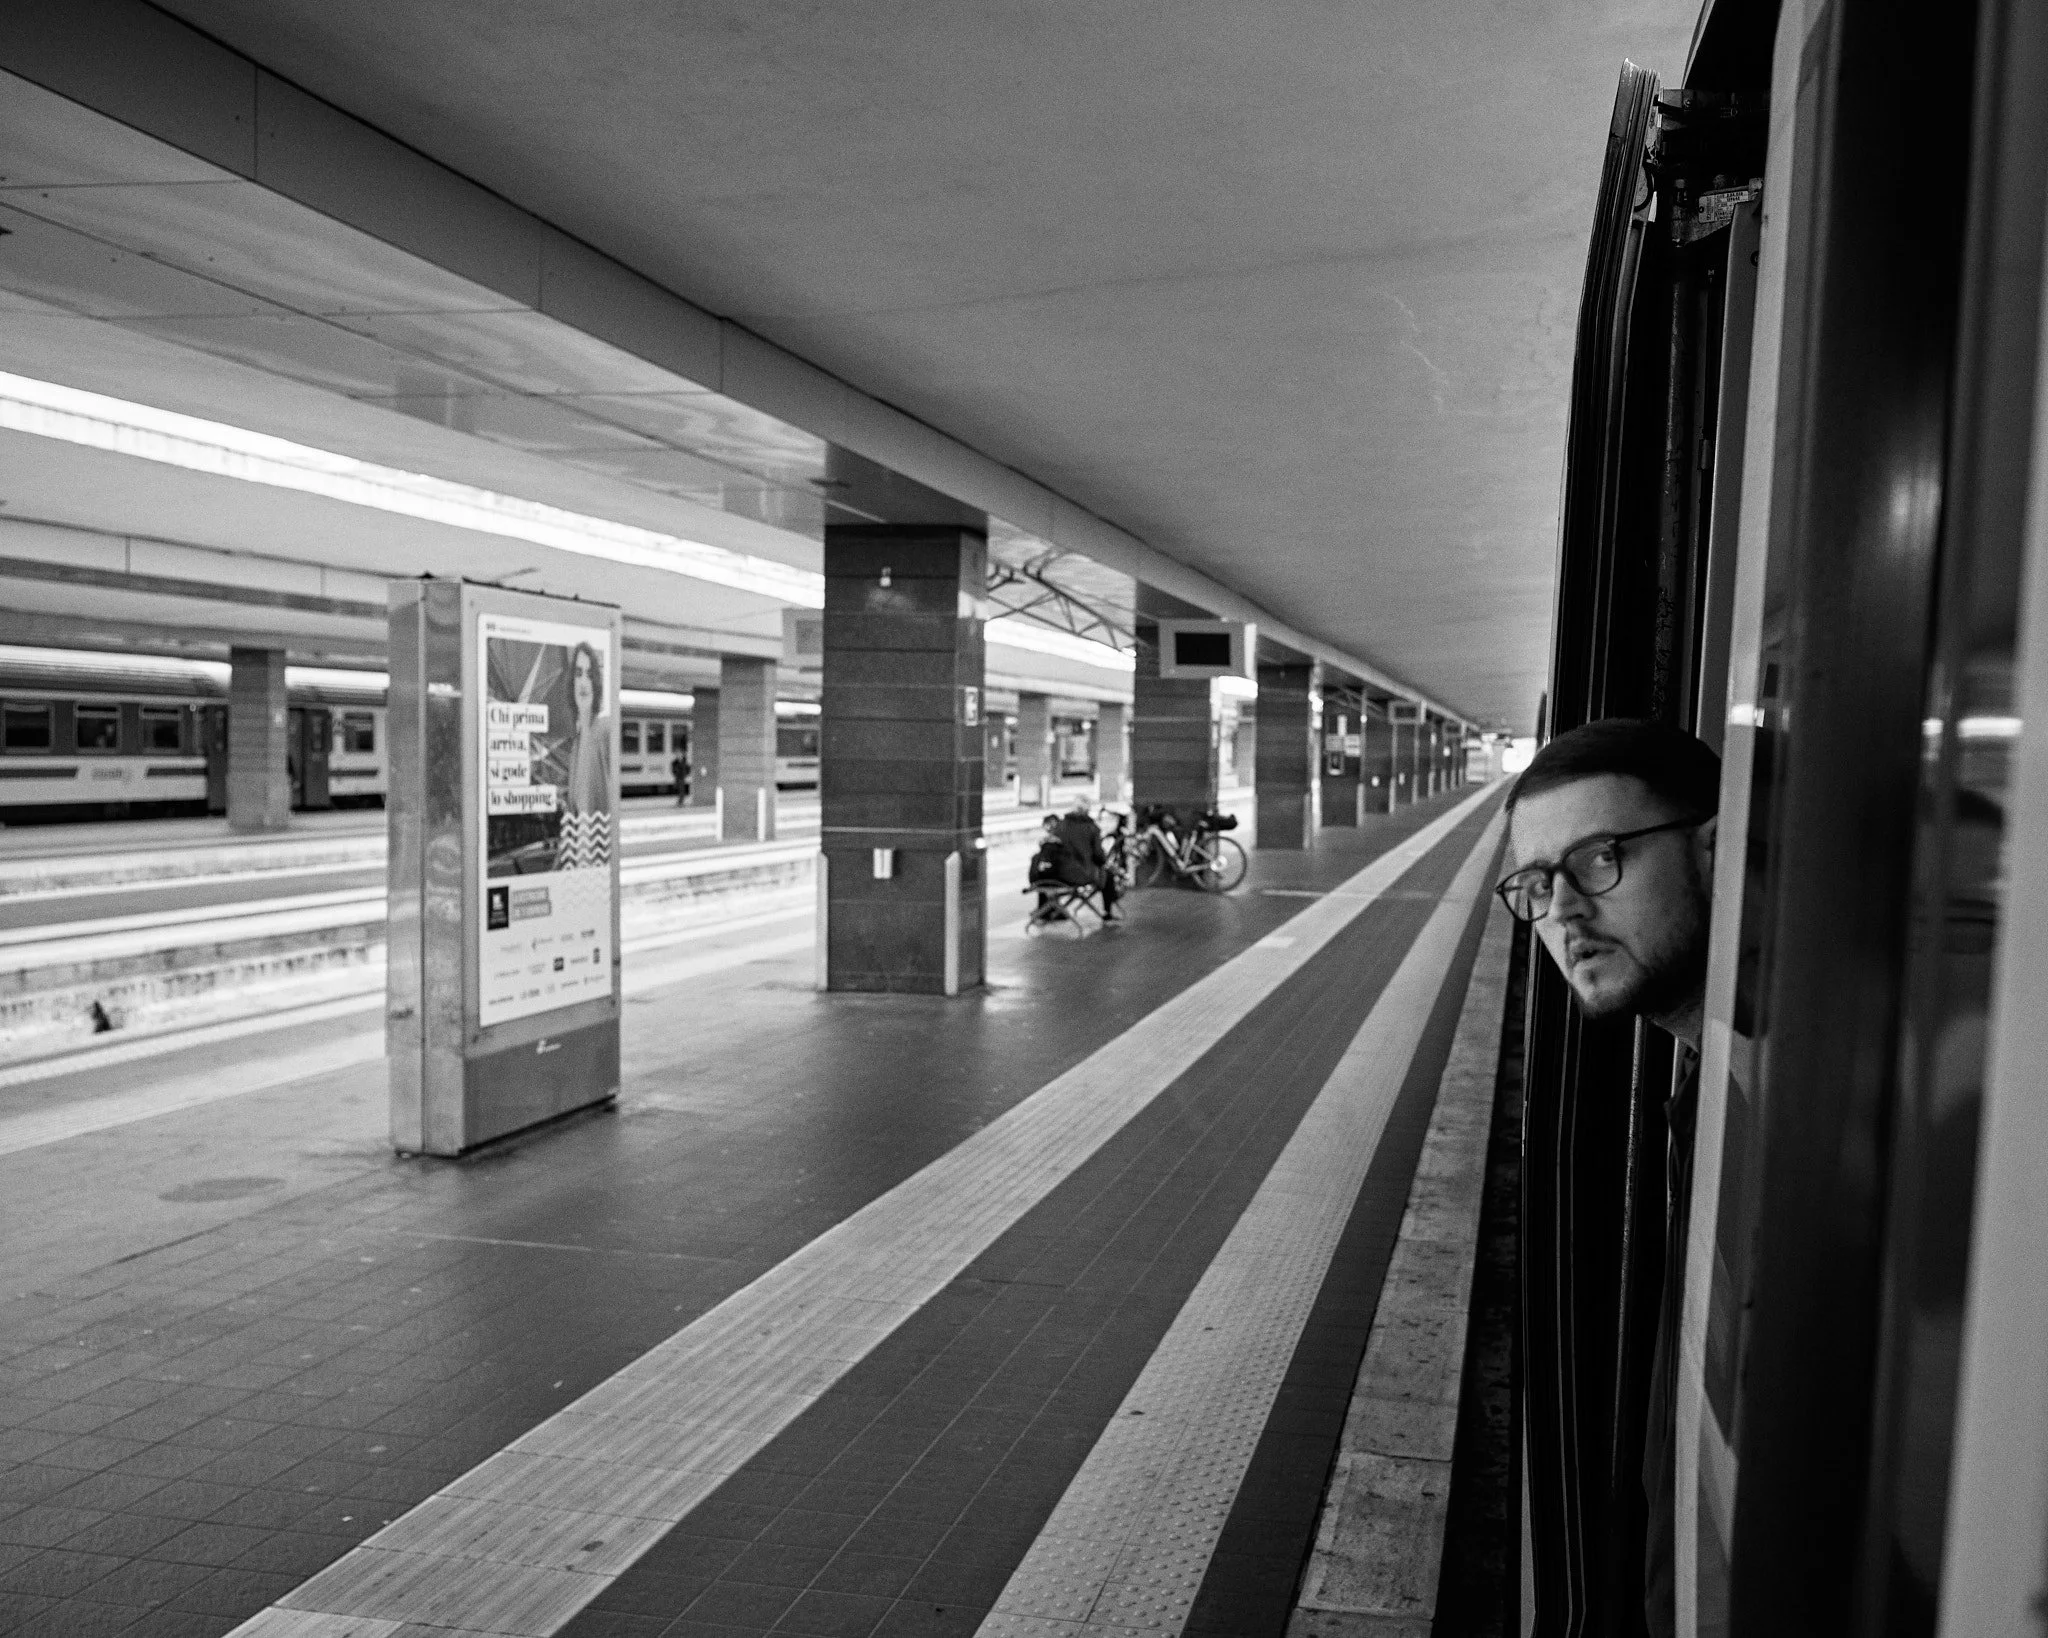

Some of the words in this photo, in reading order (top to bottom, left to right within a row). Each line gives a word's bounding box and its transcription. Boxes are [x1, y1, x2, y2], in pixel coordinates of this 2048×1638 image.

[490, 707, 509, 723] Chi
[512, 709, 544, 731] prima
[490, 760, 499, 778] si
[502, 762, 527, 781] gode
[490, 789, 500, 805] lo
